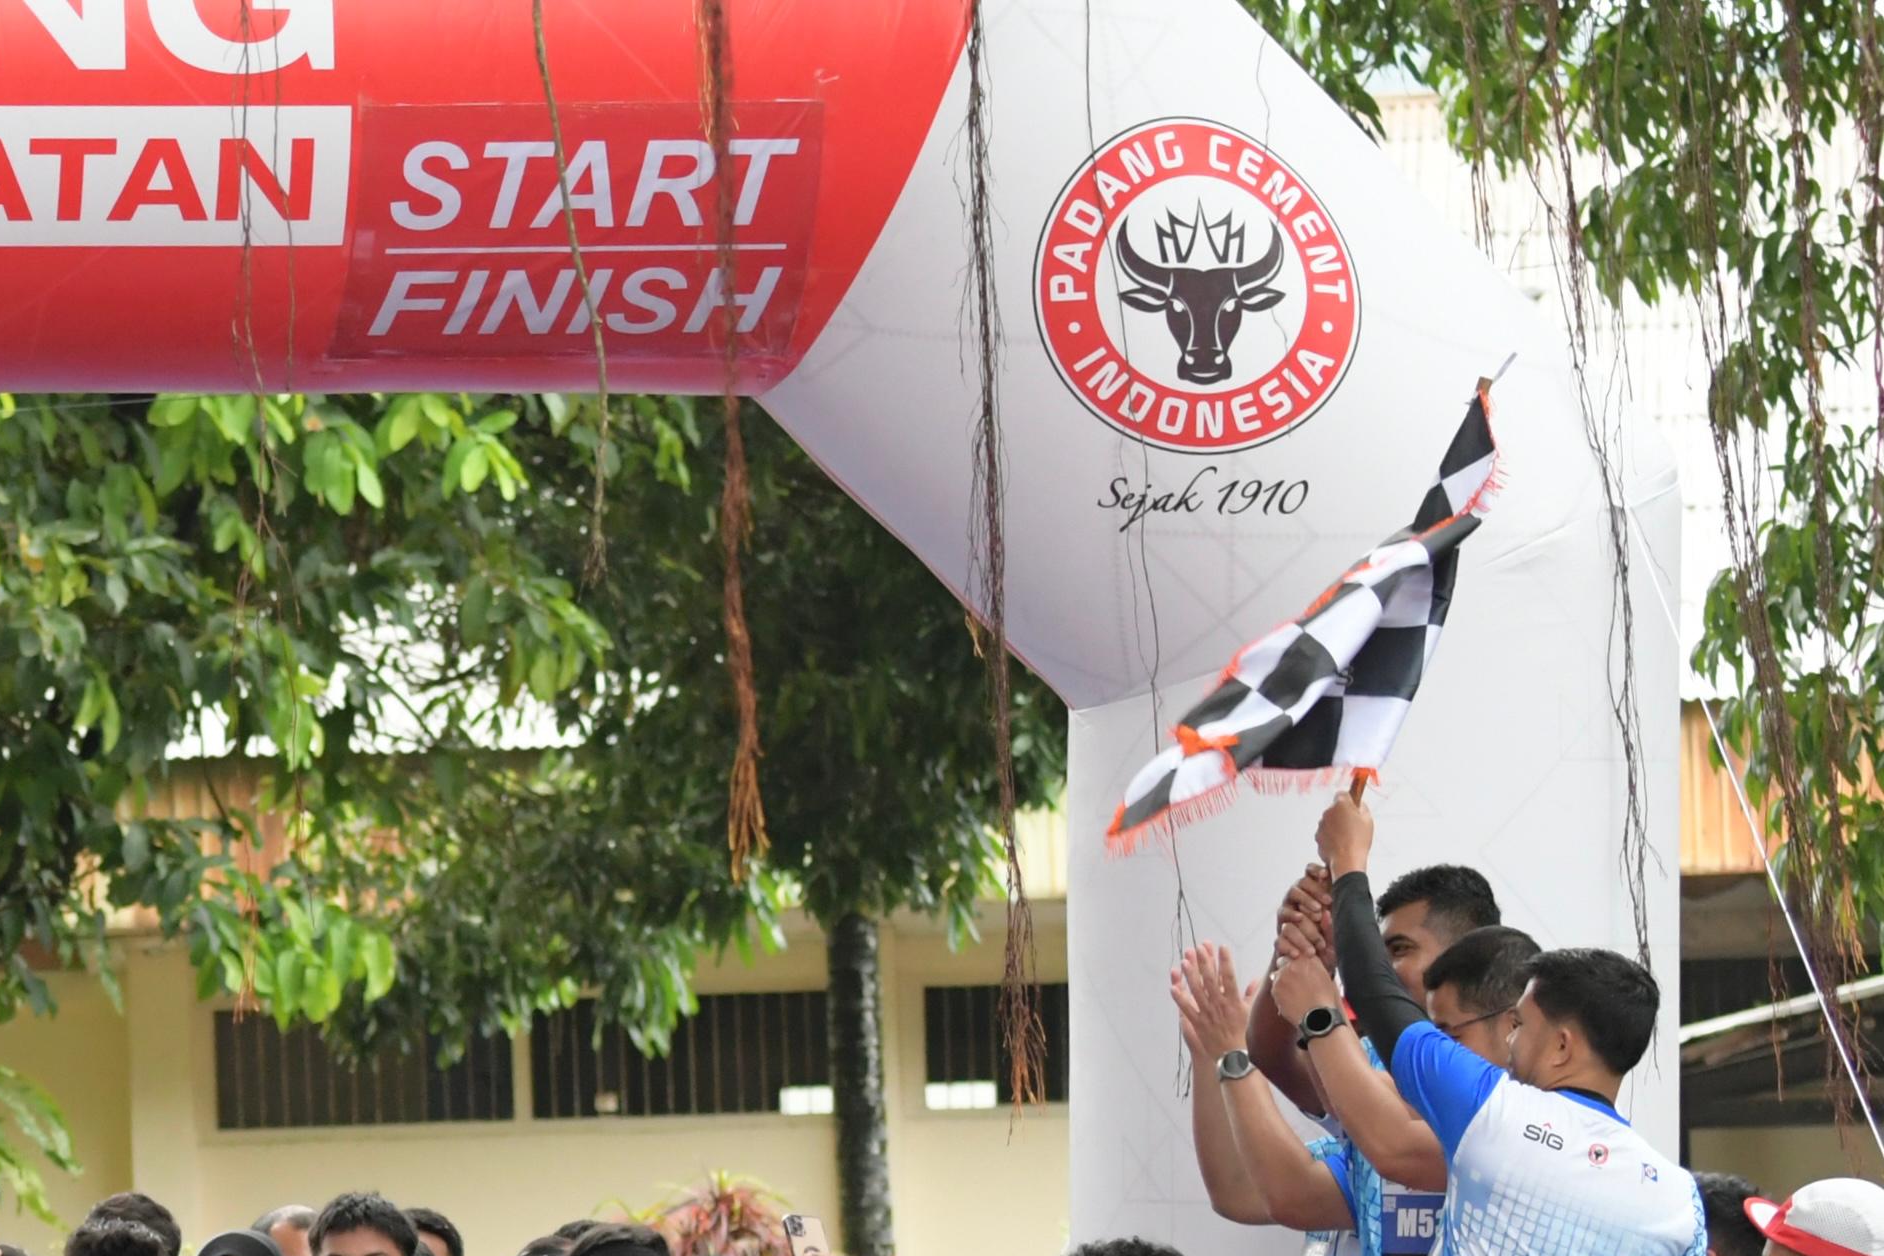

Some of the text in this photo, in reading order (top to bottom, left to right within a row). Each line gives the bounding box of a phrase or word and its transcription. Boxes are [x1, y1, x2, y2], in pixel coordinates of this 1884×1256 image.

[389, 138, 800, 231] START
[1049, 130, 1347, 303] PADANG CEMENT
[367, 266, 783, 336] FINISH
[1073, 346, 1335, 439] INDONESIA
[1098, 466, 1309, 532] Sejak 1910
